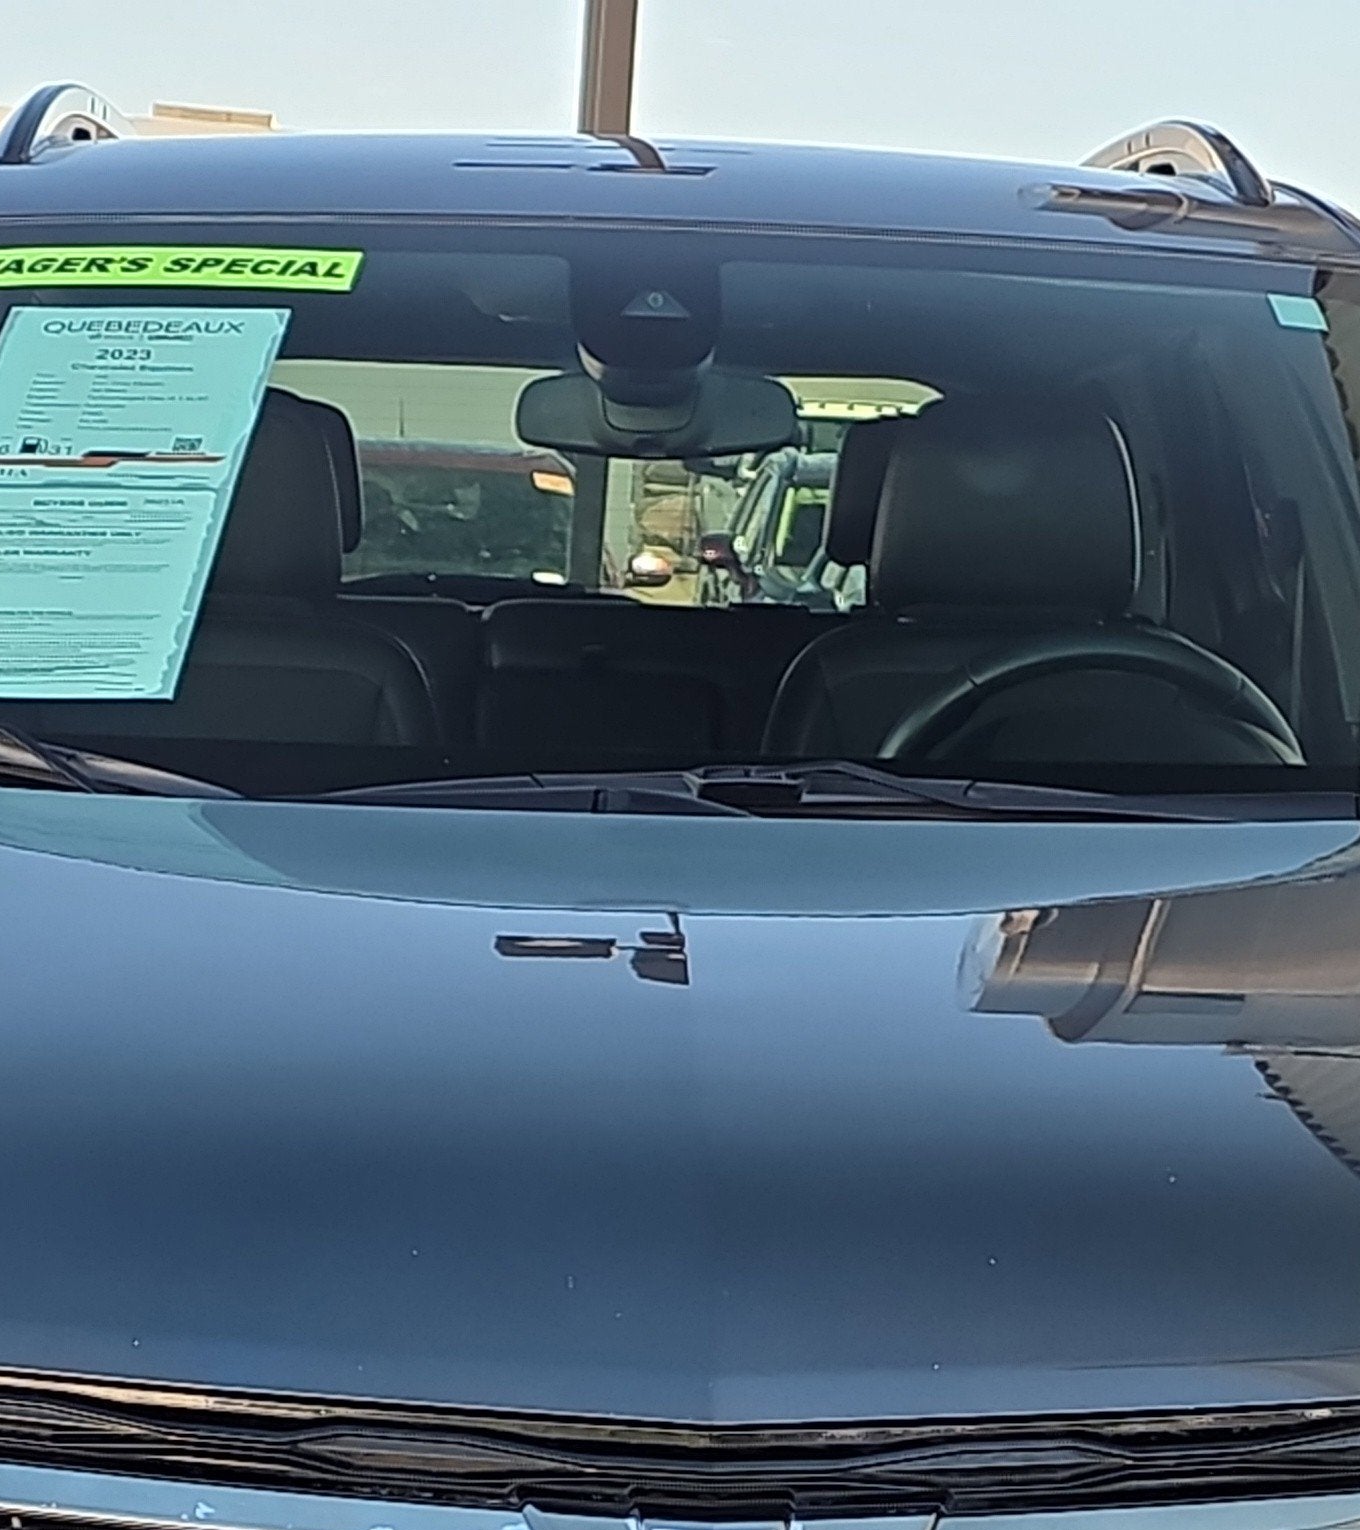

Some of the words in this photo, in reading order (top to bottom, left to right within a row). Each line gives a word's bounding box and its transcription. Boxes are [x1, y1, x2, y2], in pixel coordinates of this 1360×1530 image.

[163, 257, 346, 279] SPECIAL
[43, 320, 245, 334] QUEBEDEAUX
[95, 348, 152, 361] 2023
